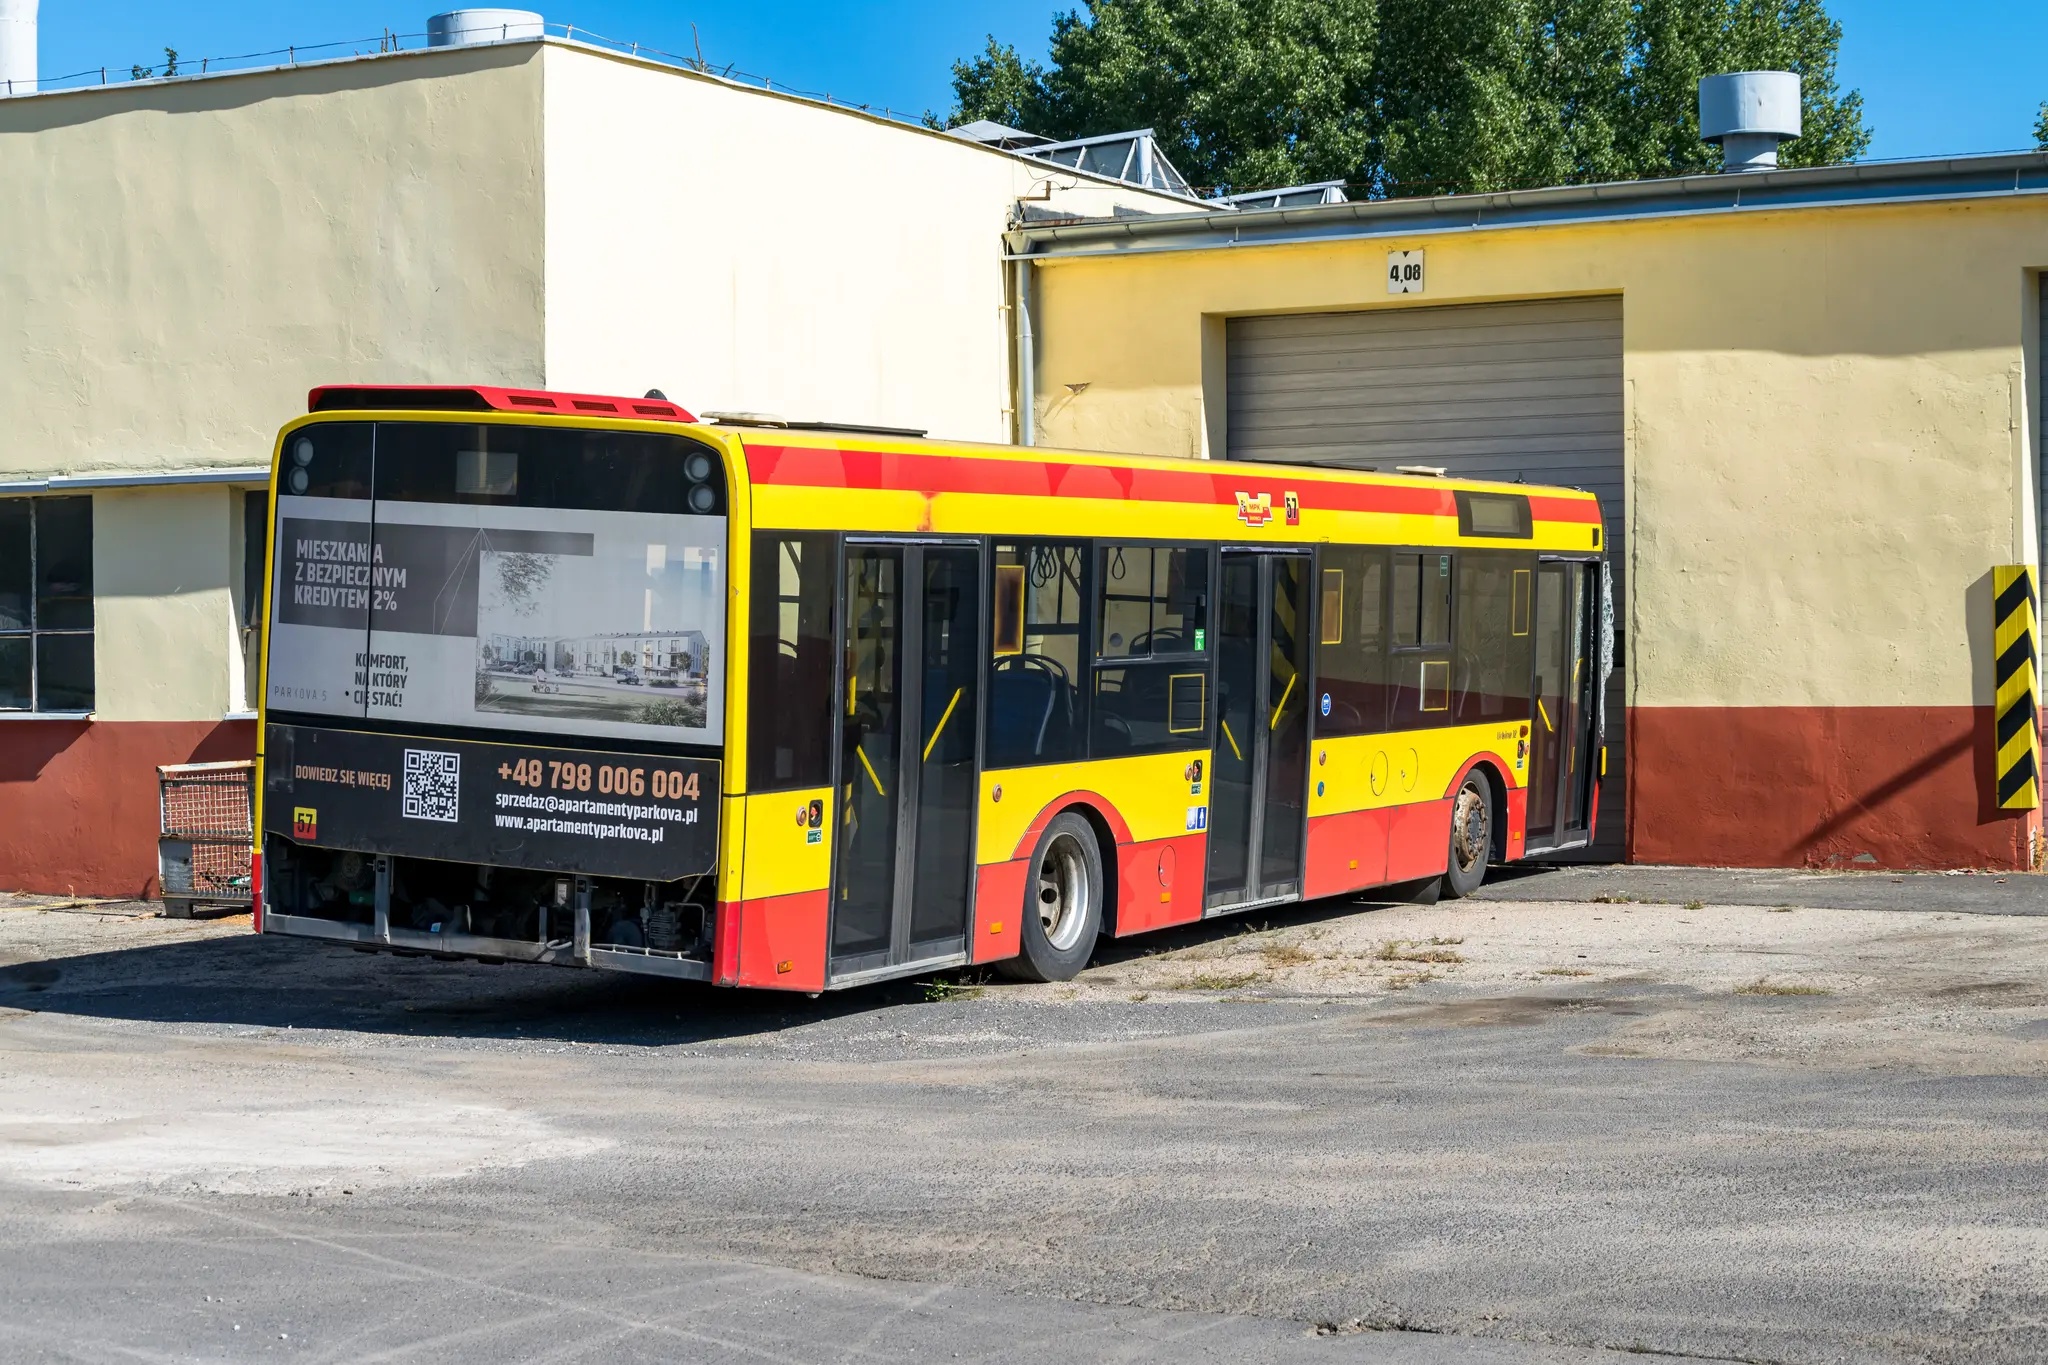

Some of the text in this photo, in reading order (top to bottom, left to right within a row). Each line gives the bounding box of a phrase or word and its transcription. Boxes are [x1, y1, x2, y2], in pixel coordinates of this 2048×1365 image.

[1390, 264, 1421, 283] 4,08
[1285, 497, 1297, 519] 57
[296, 539, 383, 564] MIESZKANIA
[295, 562, 407, 588] Z BEZPIECZNYM
[294, 585, 398, 611] KREDYTEM 2%
[355, 653, 409, 672] KOMFORT,
[372, 671, 407, 689] KTÓRY
[372, 690, 402, 707] STAĆ!
[295, 765, 391, 791] DOWIEDZ SIĘ WIĘCEJ
[498, 758, 700, 800] +48 798 006 004
[496, 793, 698, 825] sprzedaz@apartamentyparkova.pl
[297, 813, 314, 834] 57
[495, 815, 664, 844] www.apartamentyparkova.pl
